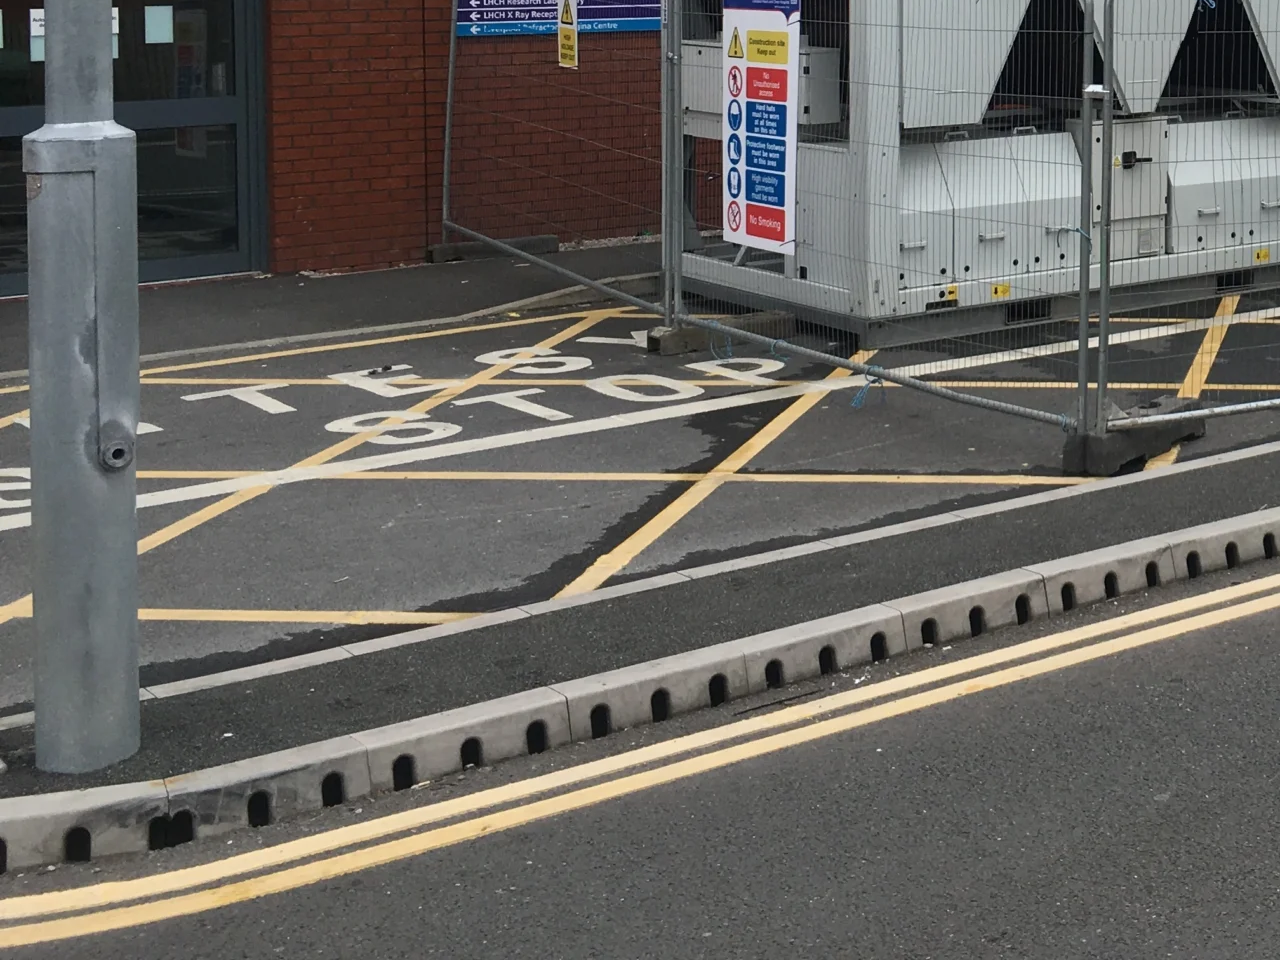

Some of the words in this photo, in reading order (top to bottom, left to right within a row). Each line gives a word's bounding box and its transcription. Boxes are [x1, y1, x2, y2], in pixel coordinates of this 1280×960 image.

[483, 11, 505, 19] LHCH
[515, 11, 529, 20] Ray
[531, 10, 558, 19] Recept
[749, 37, 776, 46] Construction
[757, 47, 768, 56] Keep
[746, 139, 766, 149] Protective
[766, 142, 785, 151] footwear
[762, 150, 768, 158] be
[751, 173, 760, 183] High
[749, 214, 757, 224] No
[758, 216, 781, 232] Smoking
[324, 357, 786, 445] STOP
